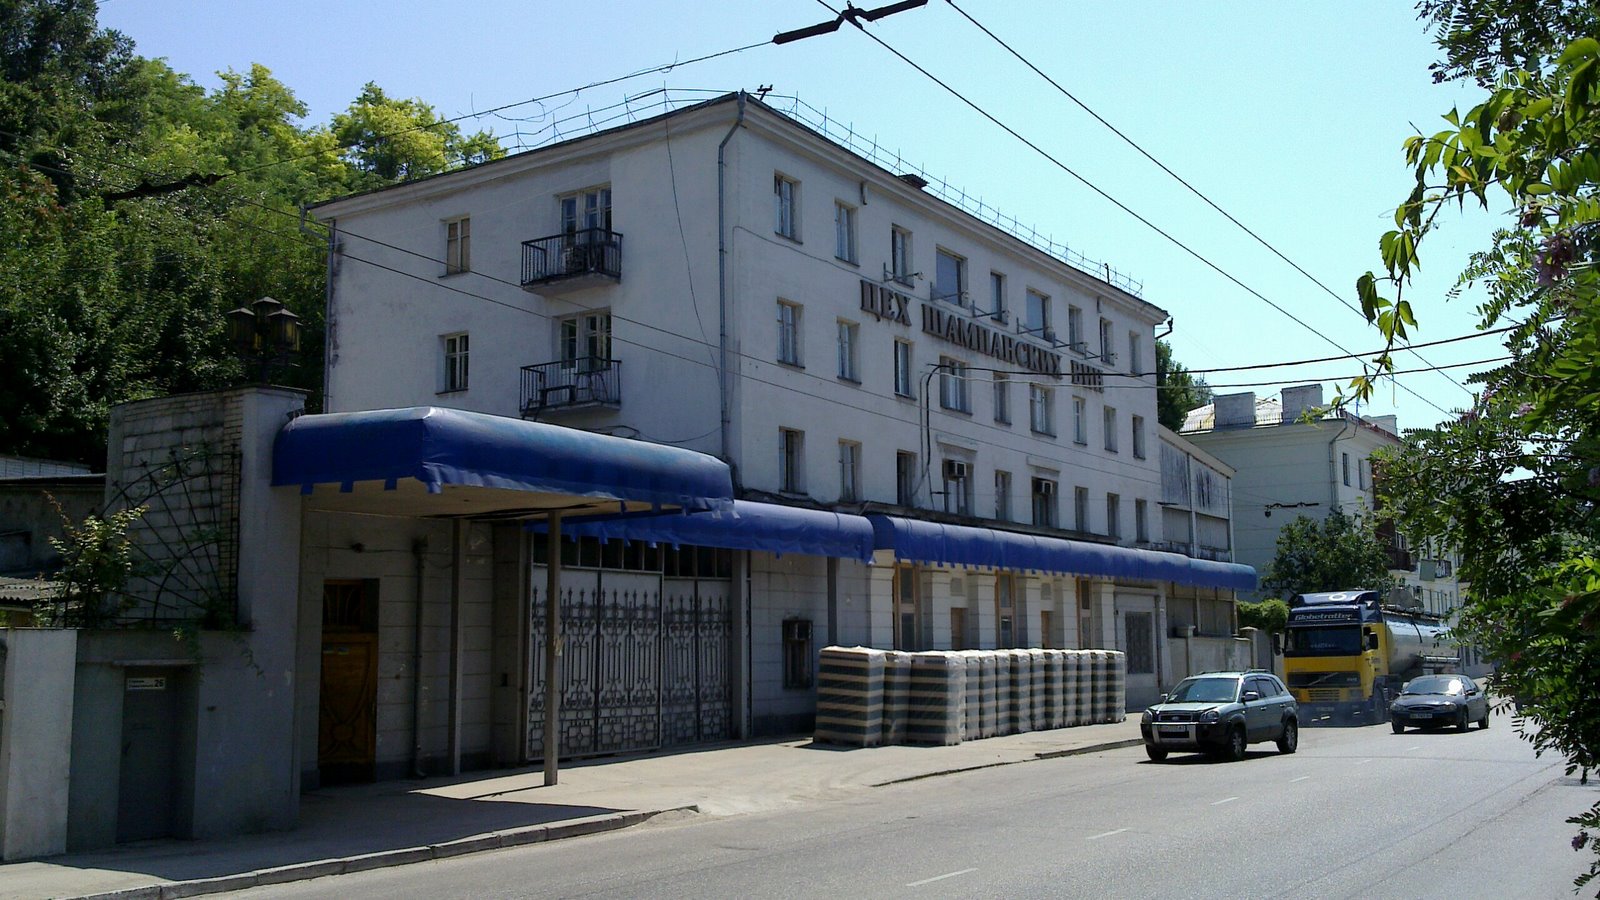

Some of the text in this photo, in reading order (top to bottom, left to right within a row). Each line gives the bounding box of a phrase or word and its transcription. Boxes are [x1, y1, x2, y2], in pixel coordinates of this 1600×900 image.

[860, 279, 1105, 394] ЦЕХ ШАМПАНСКИХ ВИН
